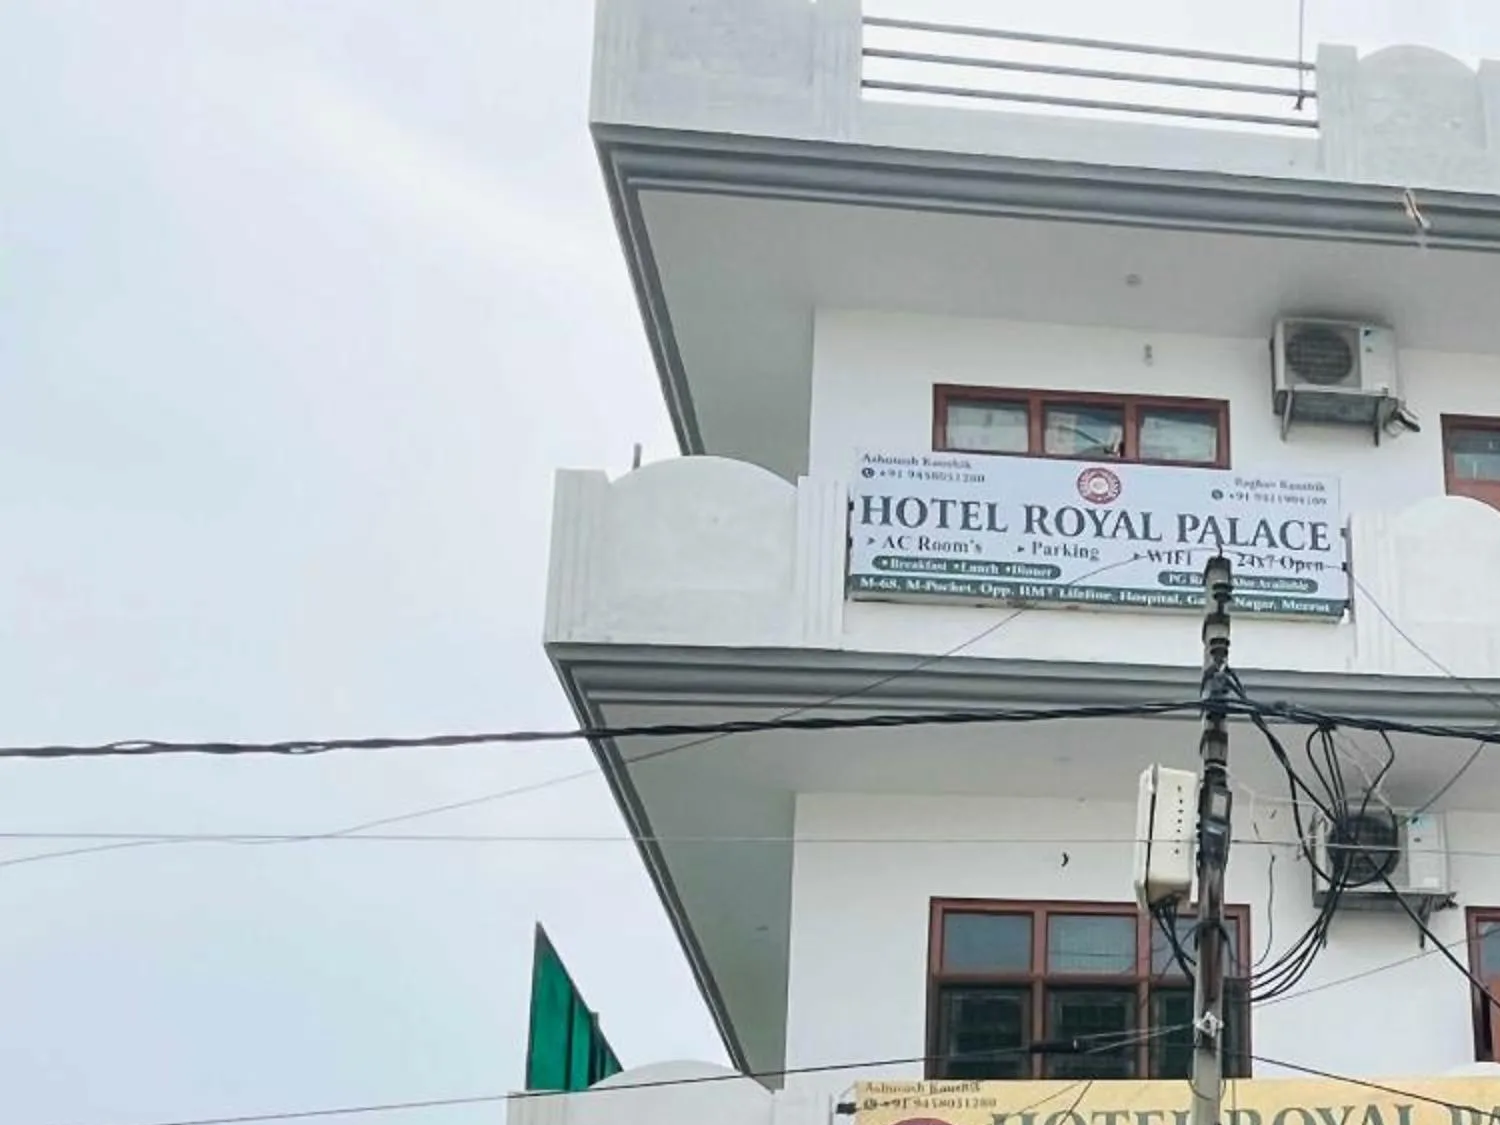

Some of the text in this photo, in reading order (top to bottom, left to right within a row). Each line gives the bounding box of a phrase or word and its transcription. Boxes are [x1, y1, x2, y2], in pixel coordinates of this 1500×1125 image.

[861, 495, 1332, 552] HOTEL ROYAL PALACE
[882, 535, 983, 555] AC Room's
[1032, 541, 1100, 561] Parking
[890, 558, 947, 572] Breakfast
[1148, 550, 1192, 566] WIFI
[1237, 552, 1325, 573] 24x7 Open
[960, 562, 1000, 575] Lunch
[1012, 565, 1053, 578] Dinner
[981, 583, 1015, 598] Opp.
[1119, 590, 1183, 606] Hospital,
[1282, 598, 1331, 614] Meerut
